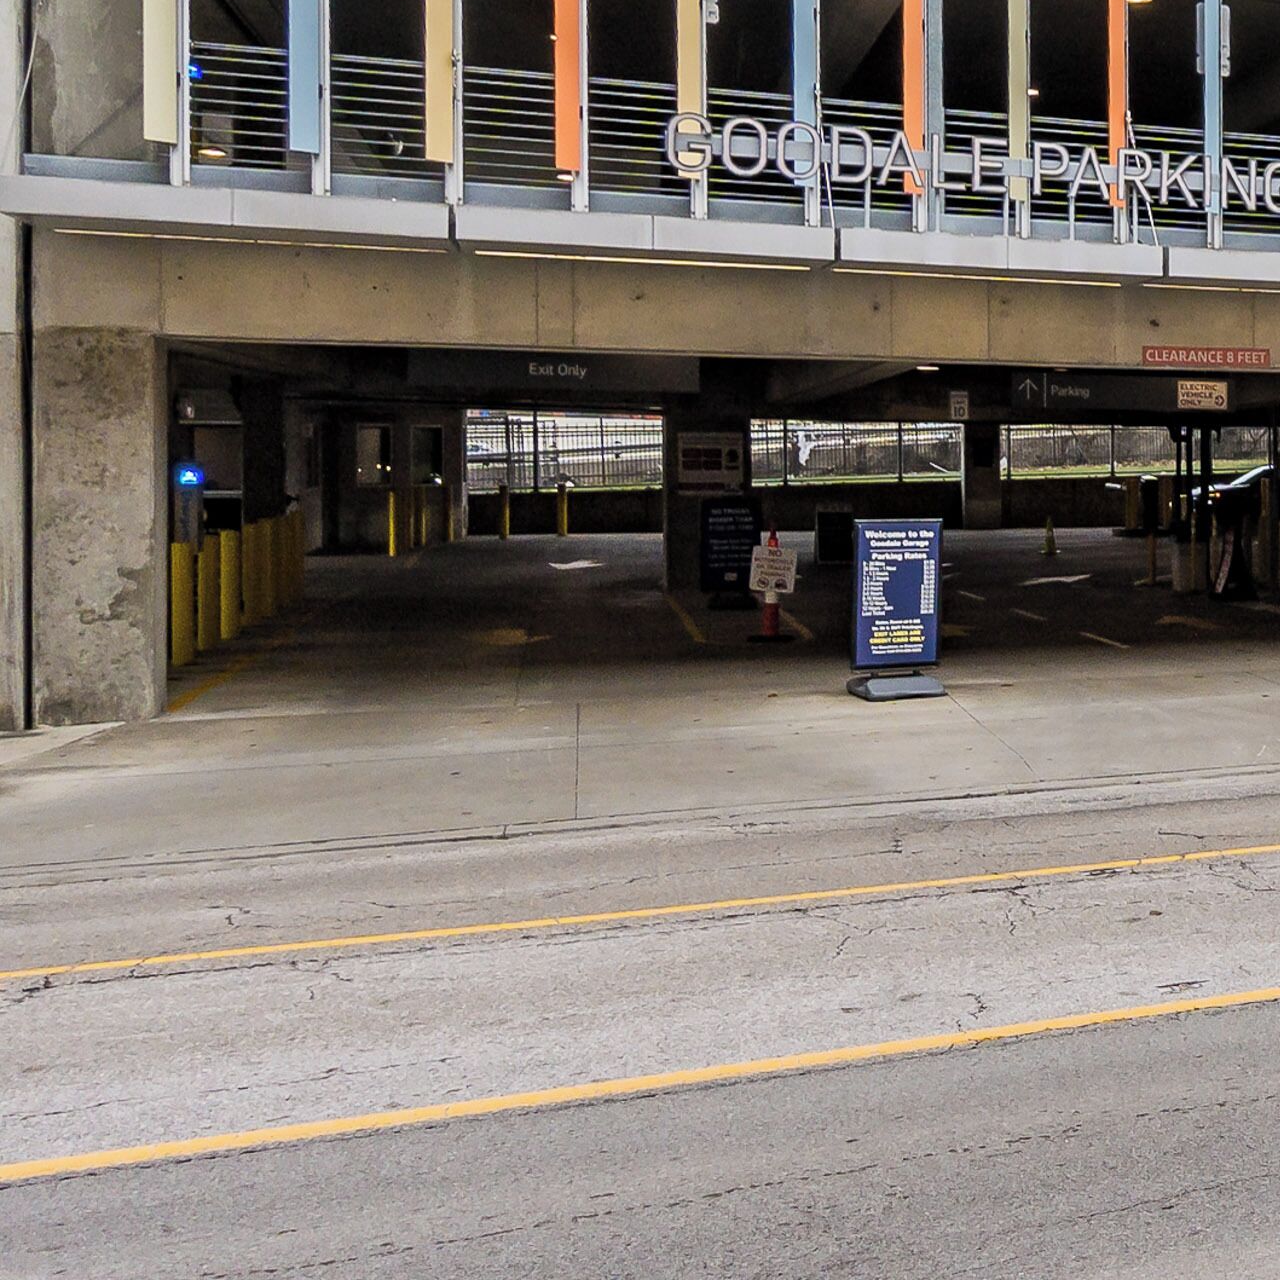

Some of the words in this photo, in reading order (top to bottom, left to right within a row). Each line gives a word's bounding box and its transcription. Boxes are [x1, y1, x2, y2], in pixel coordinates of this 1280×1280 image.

[665, 112, 1008, 194] GOODALE
[1145, 349, 1223, 364] CLEARANCE
[1226, 351, 1234, 364] 8
[1237, 351, 1266, 364] FEET
[529, 362, 553, 376] Exit
[557, 363, 588, 379] Only
[1051, 384, 1090, 398] Parking
[1180, 383, 1217, 392] ELECTRIC
[1180, 391, 1213, 399] VEHICLE
[1180, 398, 1202, 406] ONLY
[953, 406, 966, 418] 10
[865, 530, 906, 538] Welcome
[908, 530, 918, 538] to
[919, 530, 935, 538] the
[871, 552, 903, 561] Parking
[904, 552, 928, 560] Rates
